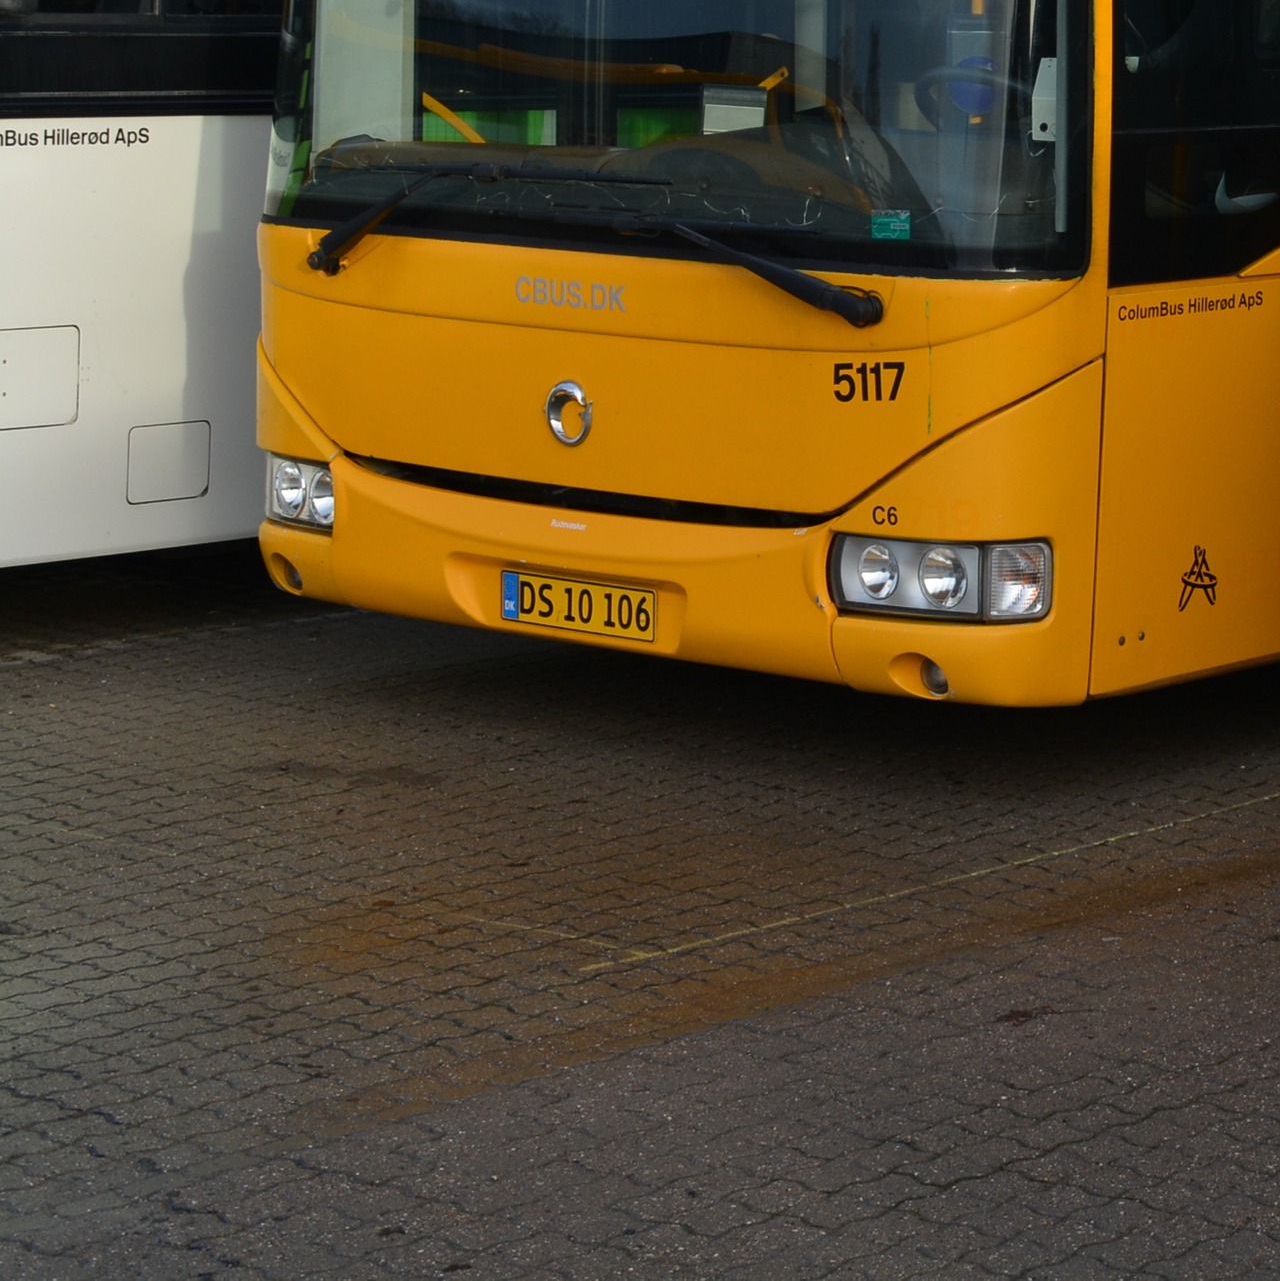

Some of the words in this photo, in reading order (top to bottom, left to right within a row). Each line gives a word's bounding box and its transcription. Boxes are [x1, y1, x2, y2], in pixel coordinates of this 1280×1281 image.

[0, 129, 39, 147] Bus
[43, 128, 110, 146] Hillerød
[114, 127, 150, 147] ApS
[515, 275, 627, 313] CBUS.DK
[1117, 301, 1184, 321] ColumBus
[1188, 293, 1236, 314] Hillerød
[1238, 291, 1264, 311] ApS
[833, 361, 905, 403] 5117
[872, 505, 899, 526] C6
[504, 599, 516, 612] DK
[519, 580, 554, 618] DS
[563, 587, 593, 624] 10
[603, 592, 651, 632] 106
